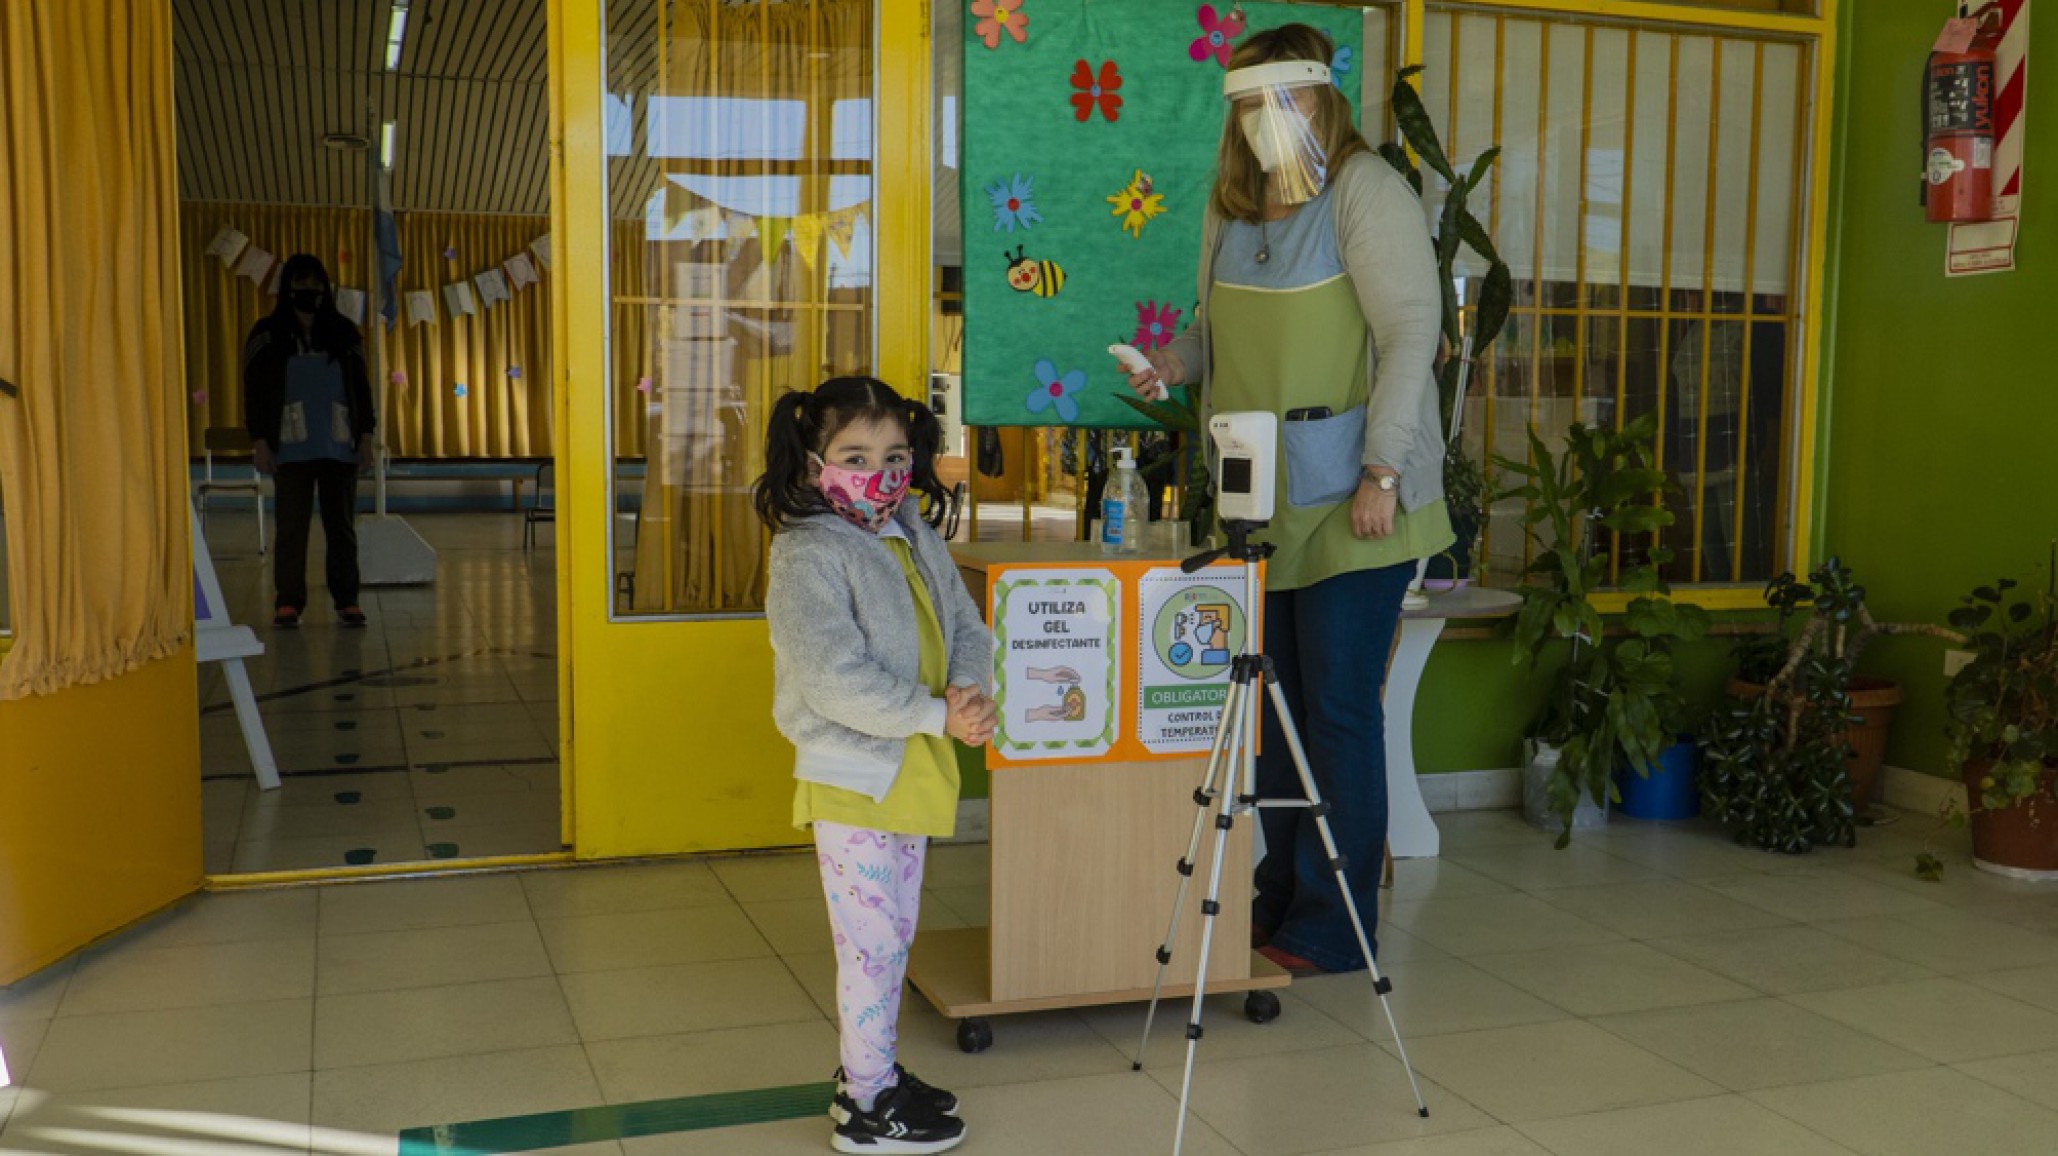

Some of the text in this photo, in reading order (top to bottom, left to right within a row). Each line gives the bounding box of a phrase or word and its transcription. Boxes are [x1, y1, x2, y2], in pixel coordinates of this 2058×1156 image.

[1028, 601, 1086, 615] UTILIZA
[1043, 620, 1070, 633] GEL
[1012, 638, 1101, 650] DESINFECTANTE
[1151, 688, 1228, 704] OBLIGATOR
[1168, 711, 1213, 723] CONTROL
